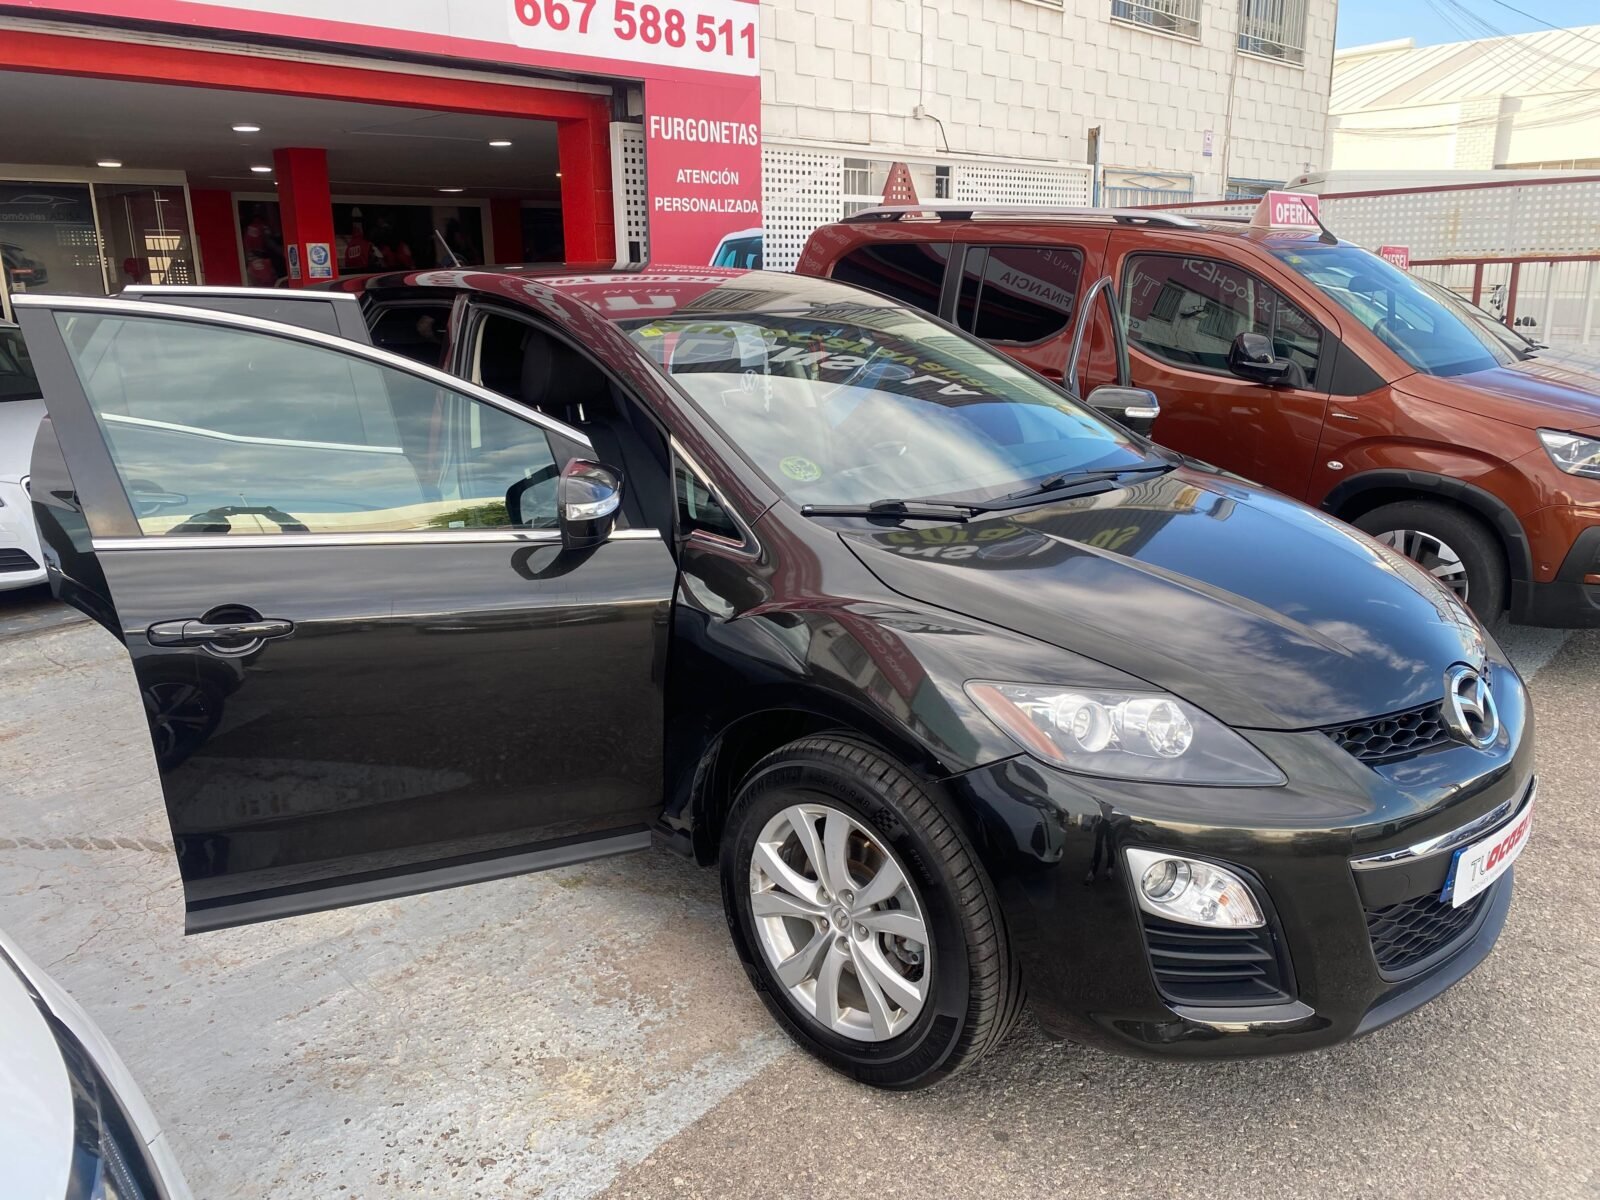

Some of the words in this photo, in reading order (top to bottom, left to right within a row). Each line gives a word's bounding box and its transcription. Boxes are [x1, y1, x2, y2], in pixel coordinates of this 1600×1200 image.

[514, 0, 596, 33] 667
[613, 1, 686, 48] 588
[695, 14, 756, 59] 511
[650, 115, 758, 146] FURGONETAS
[676, 168, 739, 185] ATENCIÓN
[655, 197, 759, 214] PERSONALIZADA
[1276, 202, 1314, 224] OFERTA
